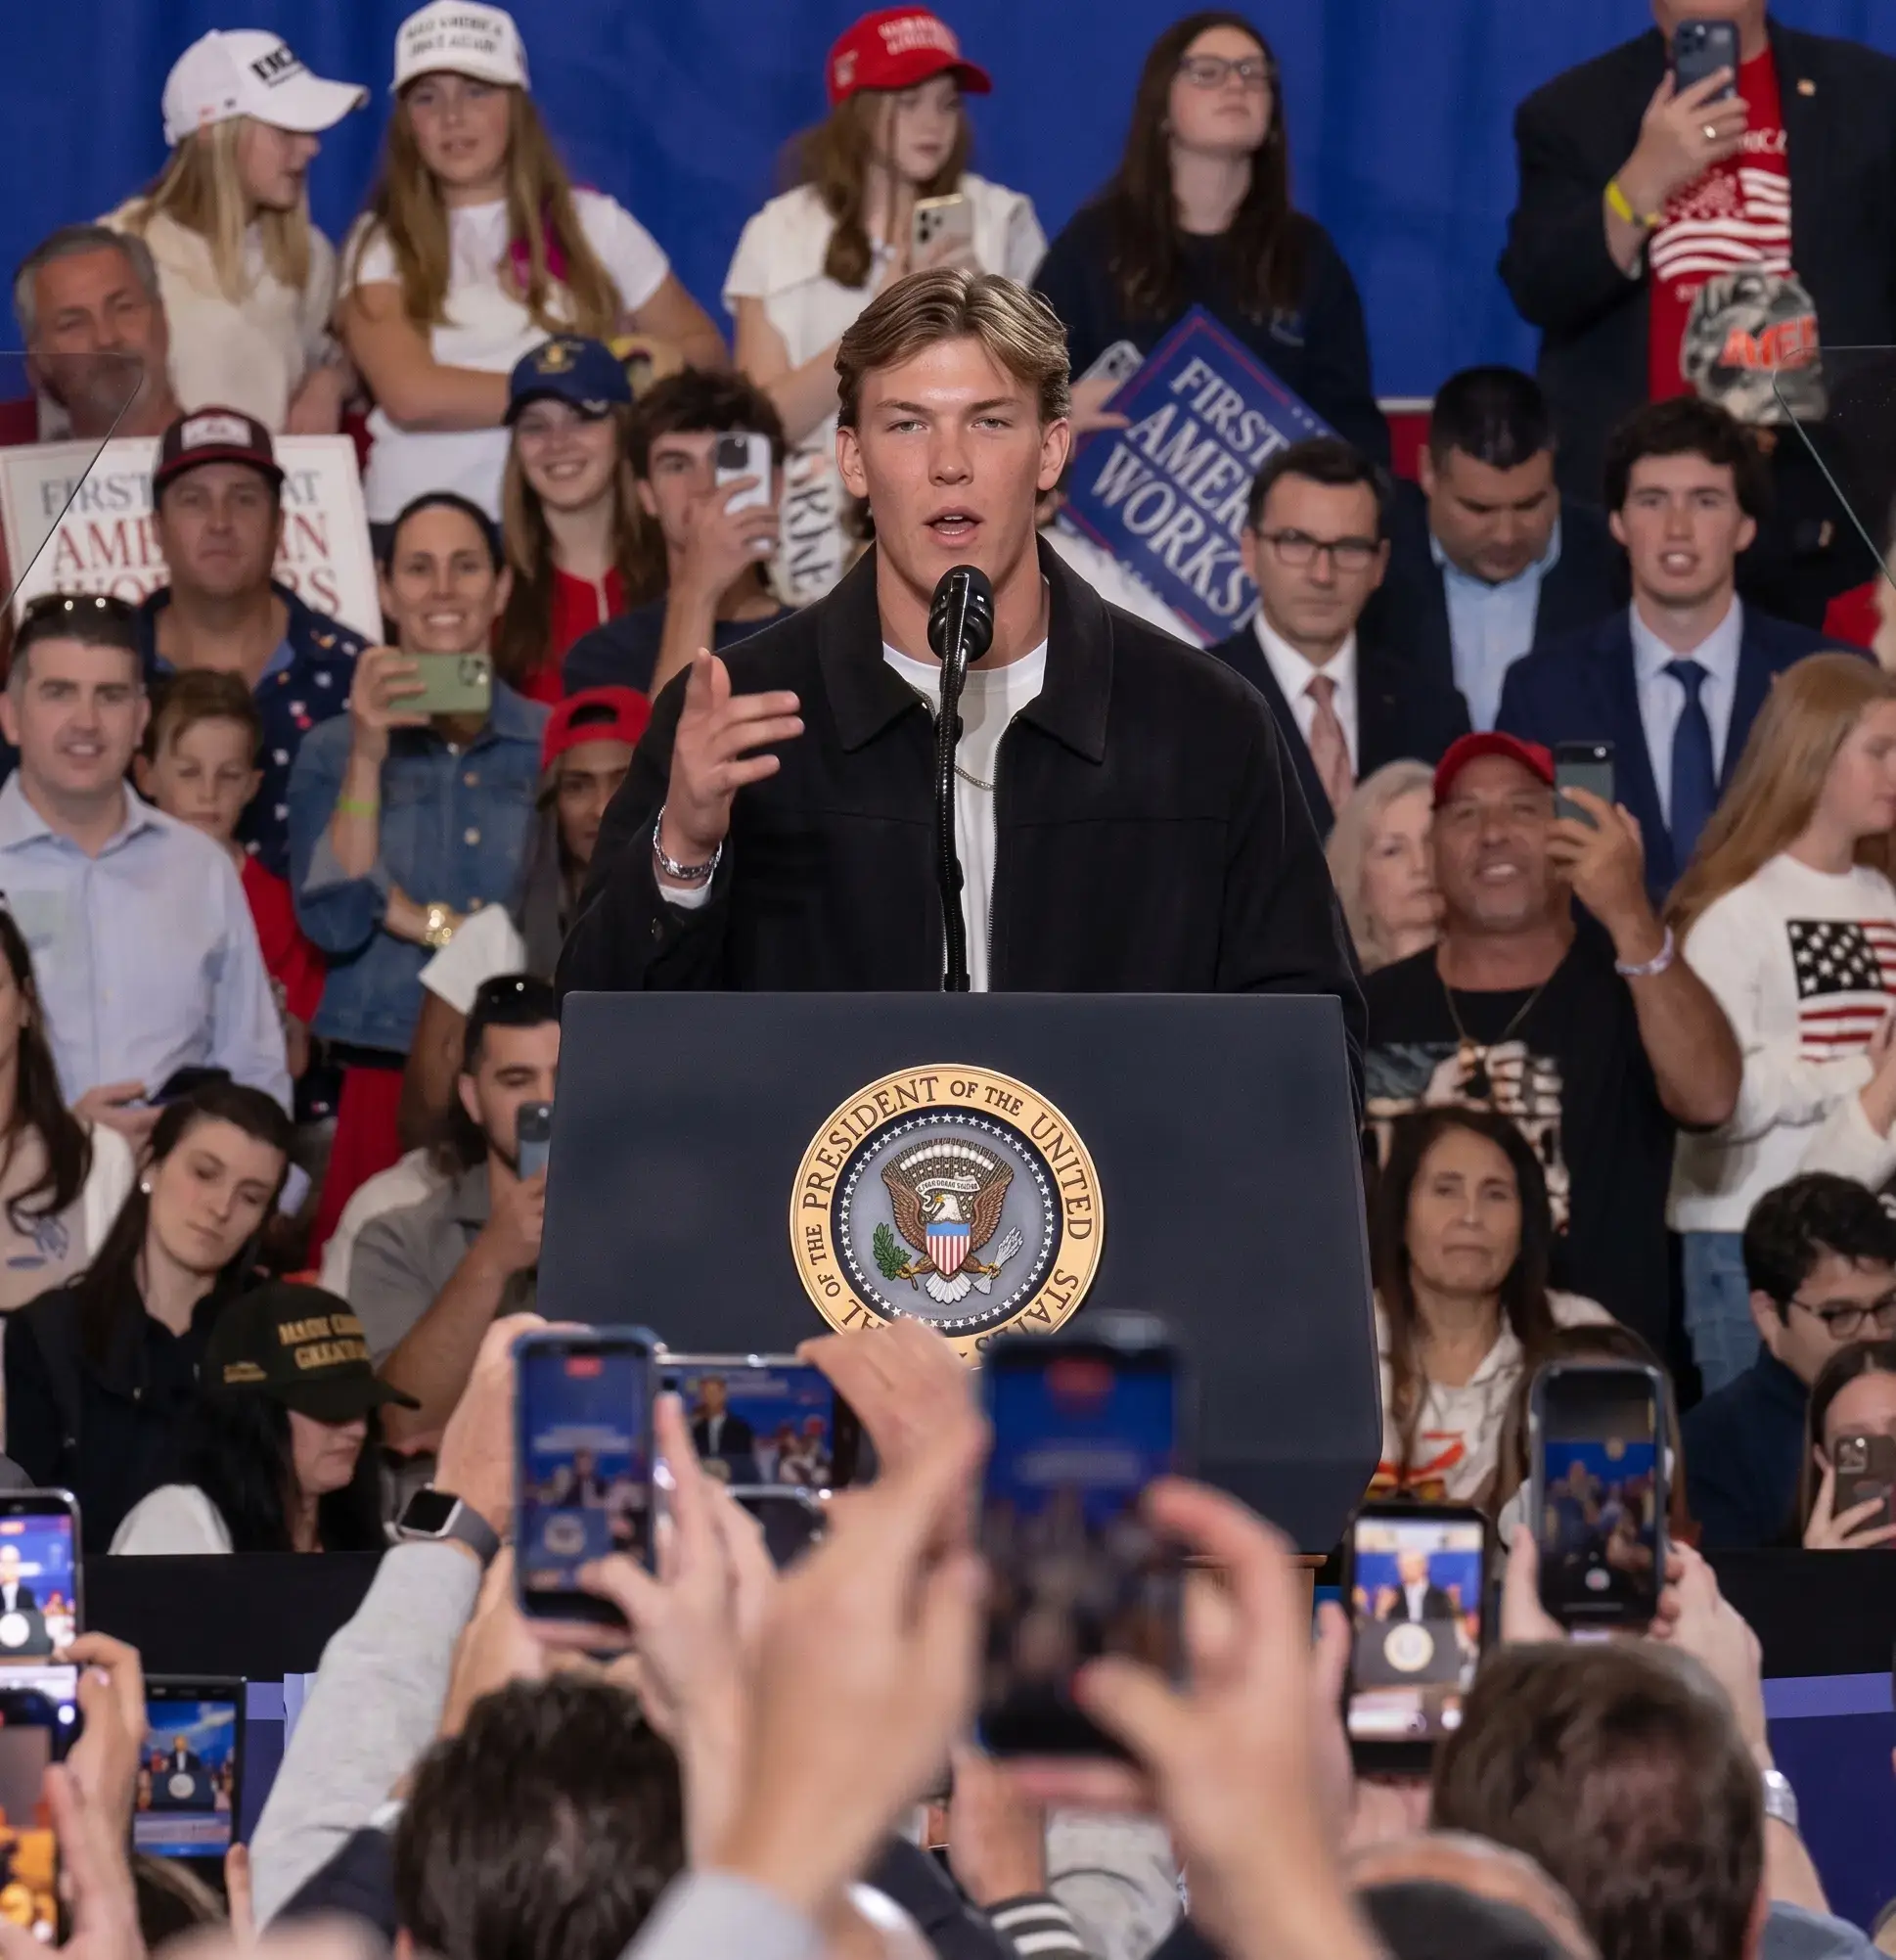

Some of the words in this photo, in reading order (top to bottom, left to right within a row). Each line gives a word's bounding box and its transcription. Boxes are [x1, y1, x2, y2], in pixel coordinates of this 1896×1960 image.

[1169, 356, 1290, 468] FIRST
[950, 1080, 978, 1098] OF
[984, 1085, 1024, 1117] THE
[802, 1075, 939, 1211] PRESIDENT
[1030, 1112, 1093, 1240] UNITED
[805, 1224, 828, 1266] THE
[817, 1274, 841, 1298] OF
